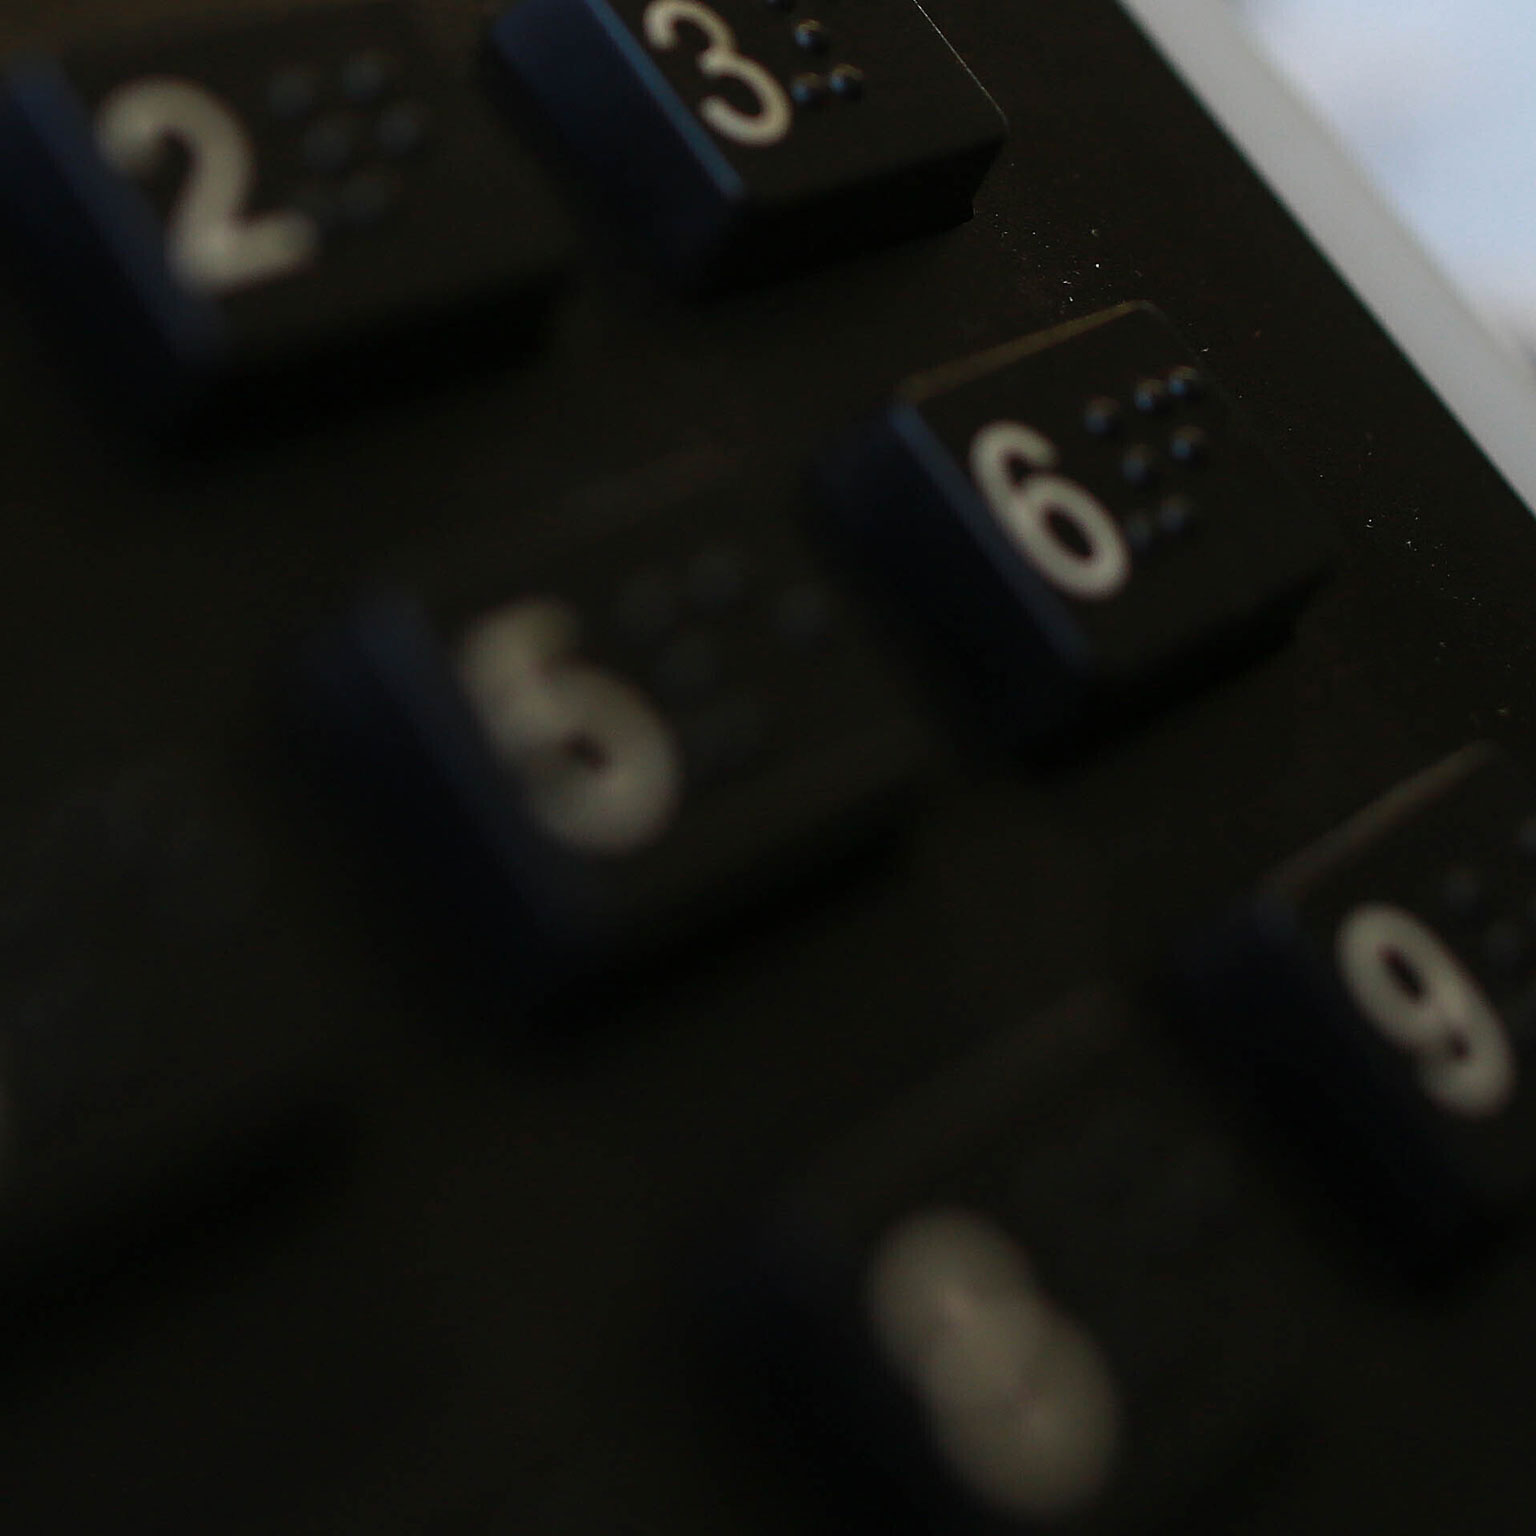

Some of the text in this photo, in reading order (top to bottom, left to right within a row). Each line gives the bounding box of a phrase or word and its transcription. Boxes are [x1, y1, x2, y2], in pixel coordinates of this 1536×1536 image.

[94, 79, 312, 294] 2
[970, 421, 1129, 597] 6
[458, 603, 679, 850] 5
[1337, 904, 1513, 1114] 9
